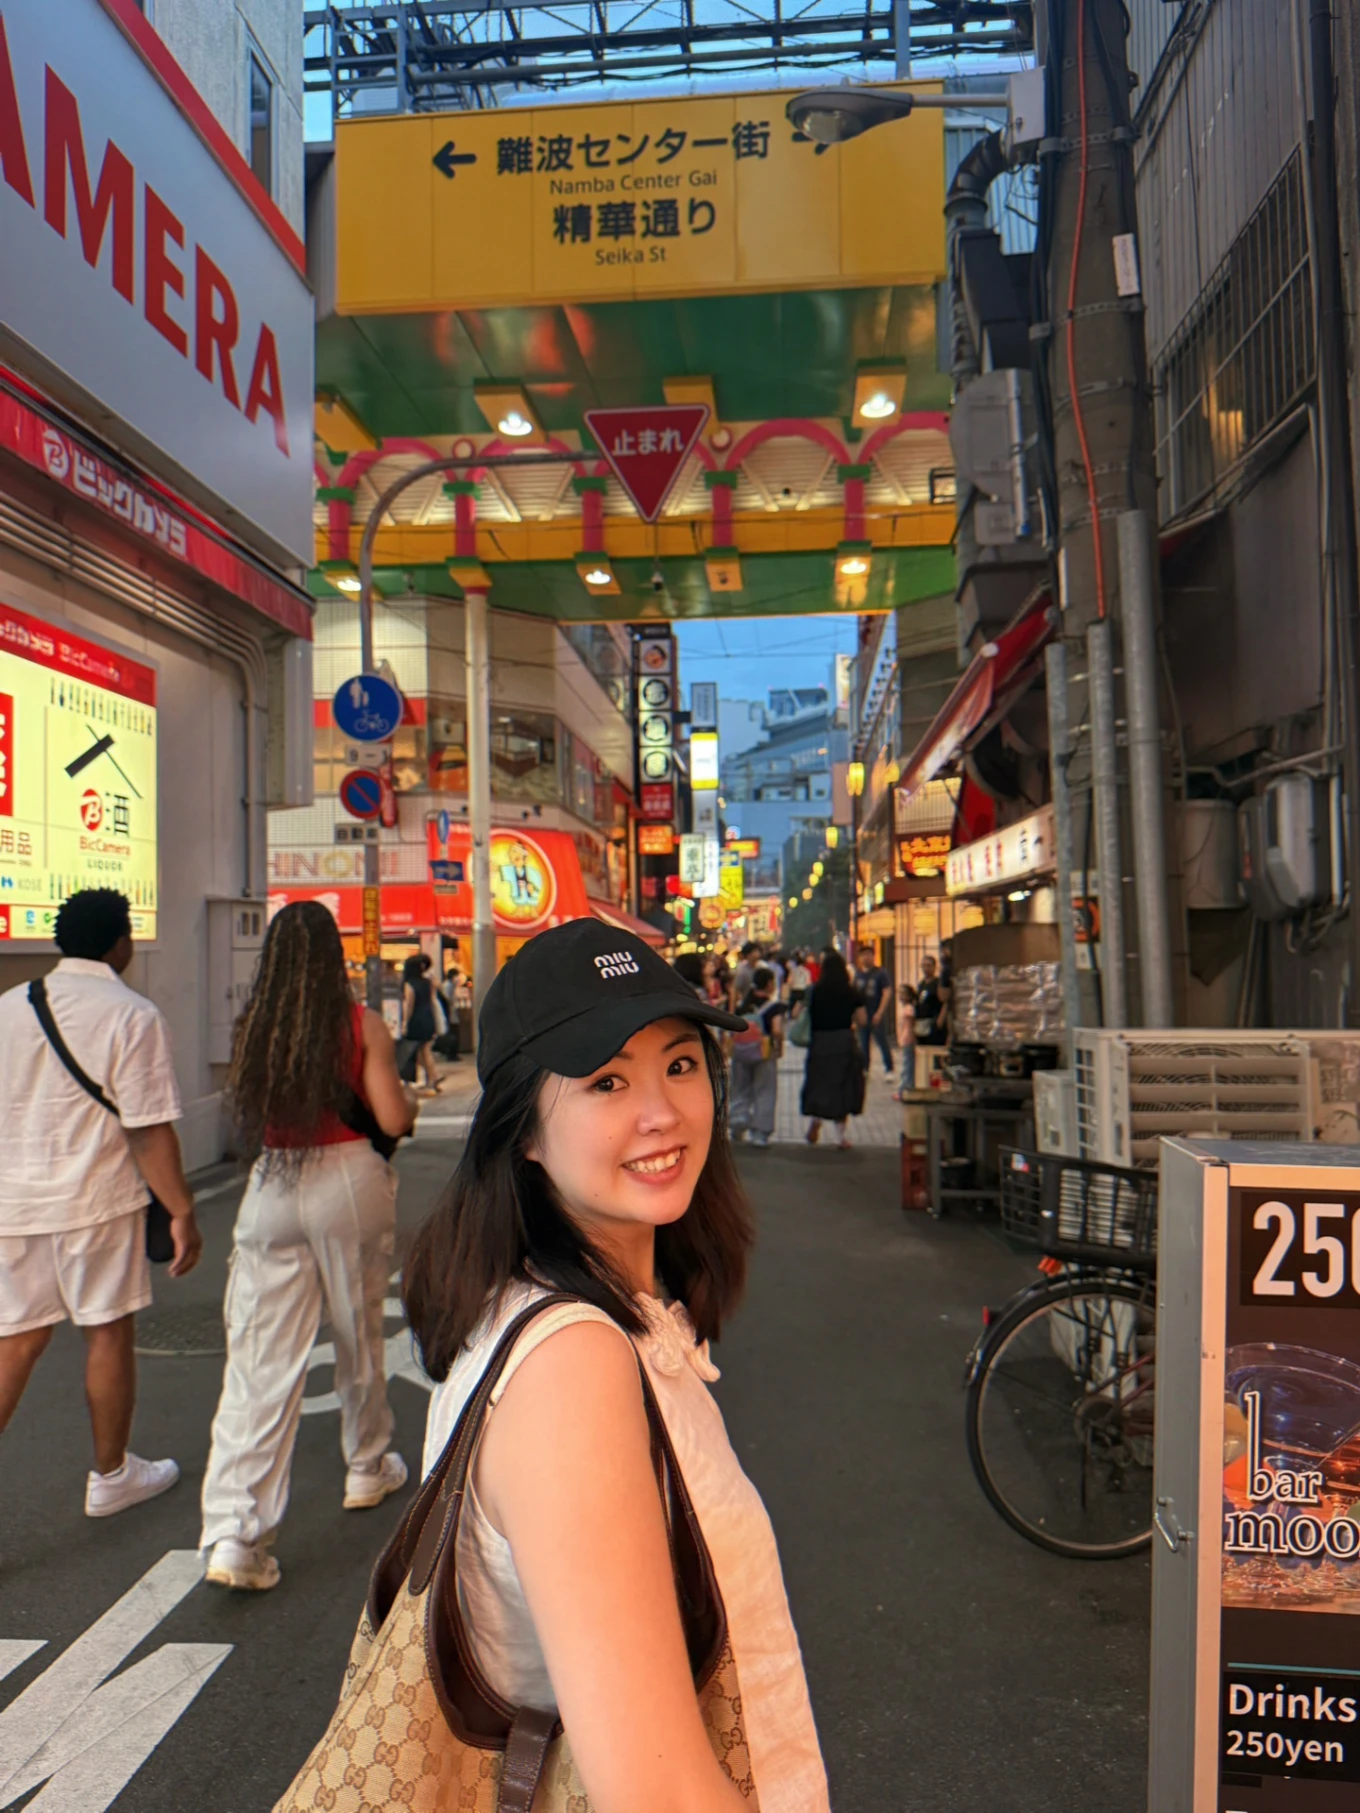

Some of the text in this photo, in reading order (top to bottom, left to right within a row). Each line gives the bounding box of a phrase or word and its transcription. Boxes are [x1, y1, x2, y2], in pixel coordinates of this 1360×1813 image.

[497, 121, 771, 175] 難波センター街
[550, 169, 718, 195] Namba Center Gai
[553, 199, 717, 244] 精華通り
[595, 246, 667, 266] Seika St
[612, 427, 684, 456] 止まれ
[73, 450, 187, 558] ビックカメラ
[79, 836, 131, 857] BicCamera
[1252, 1201, 1360, 1298] 25
[1229, 1682, 1357, 1723] Drinks
[1225, 1729, 1344, 1766] 250yen
